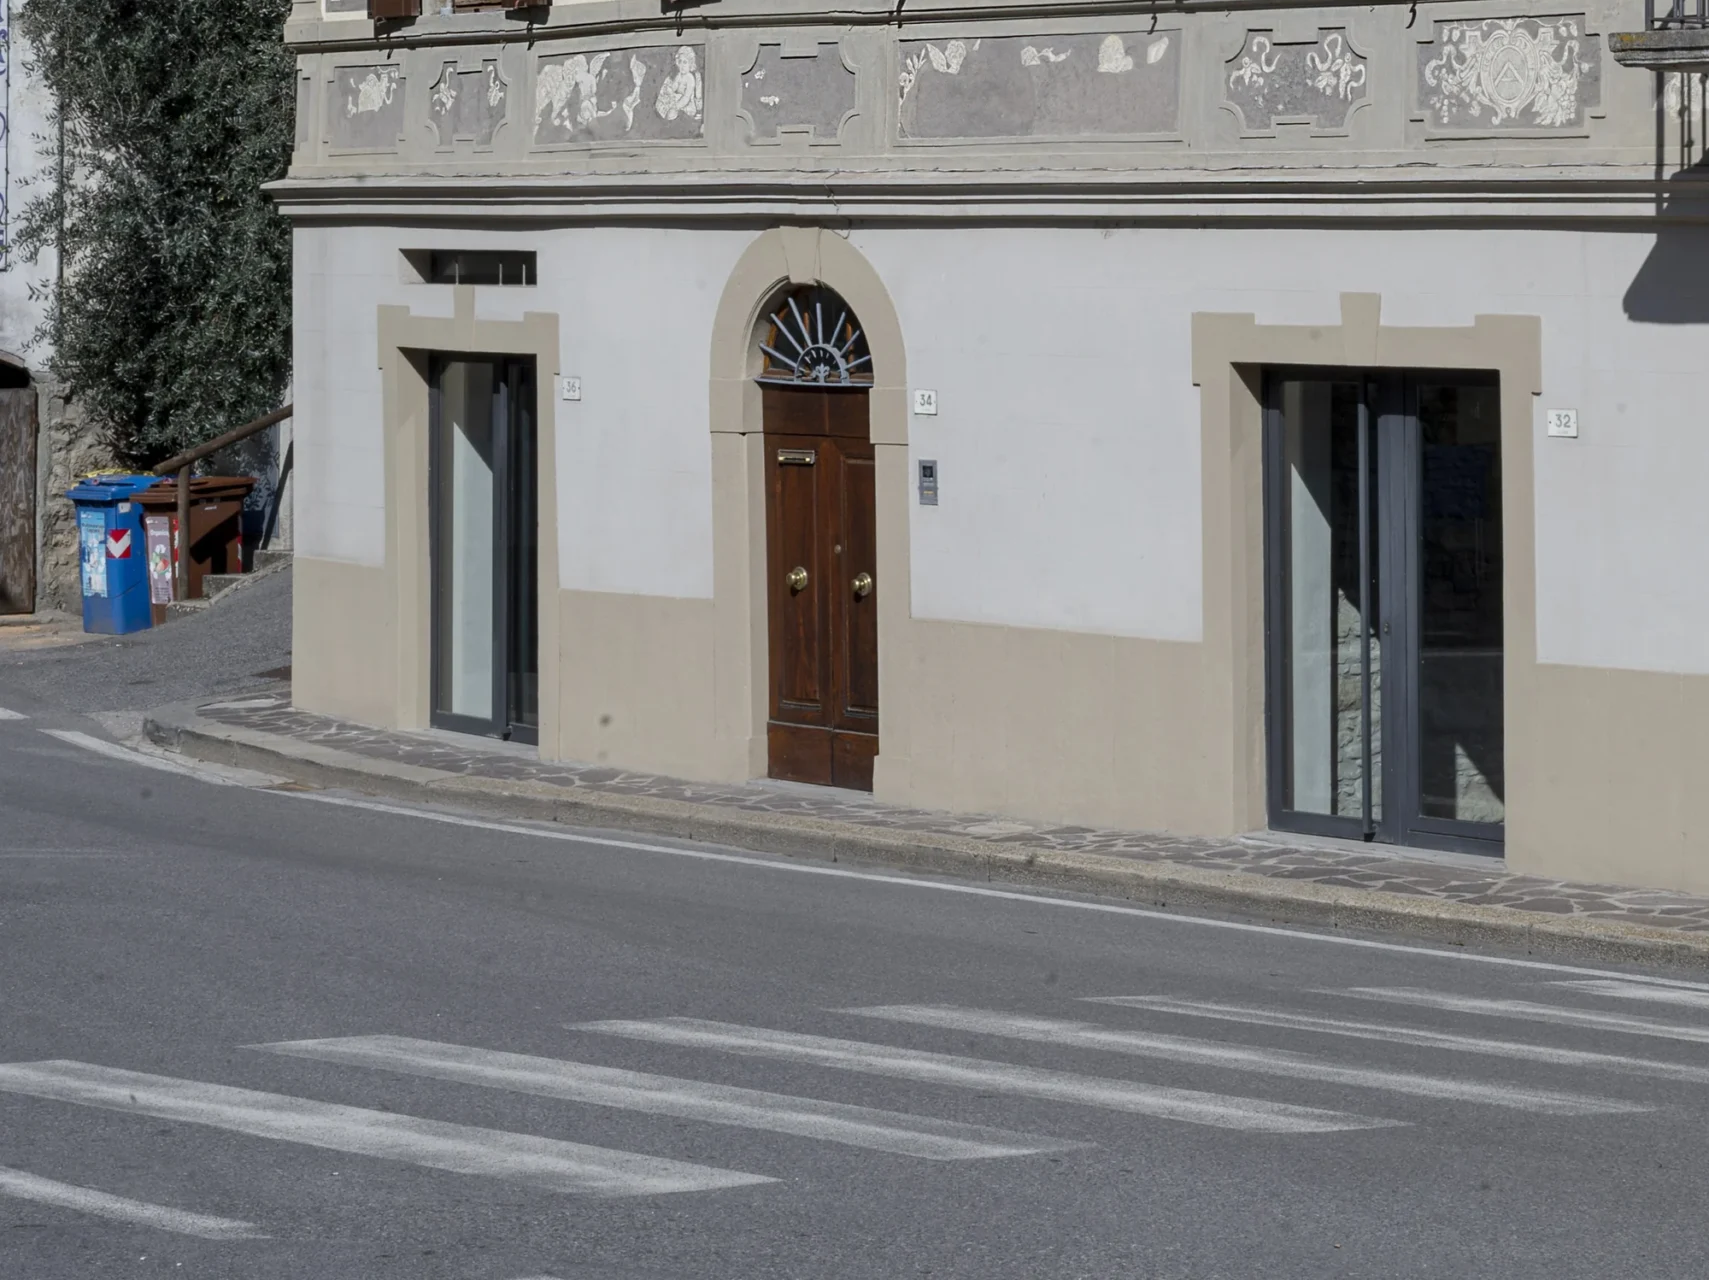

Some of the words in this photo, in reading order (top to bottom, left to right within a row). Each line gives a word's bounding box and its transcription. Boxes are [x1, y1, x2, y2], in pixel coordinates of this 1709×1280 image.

[566, 380, 577, 393] 36
[919, 393, 933, 407] 34
[1555, 413, 1572, 429] 32
